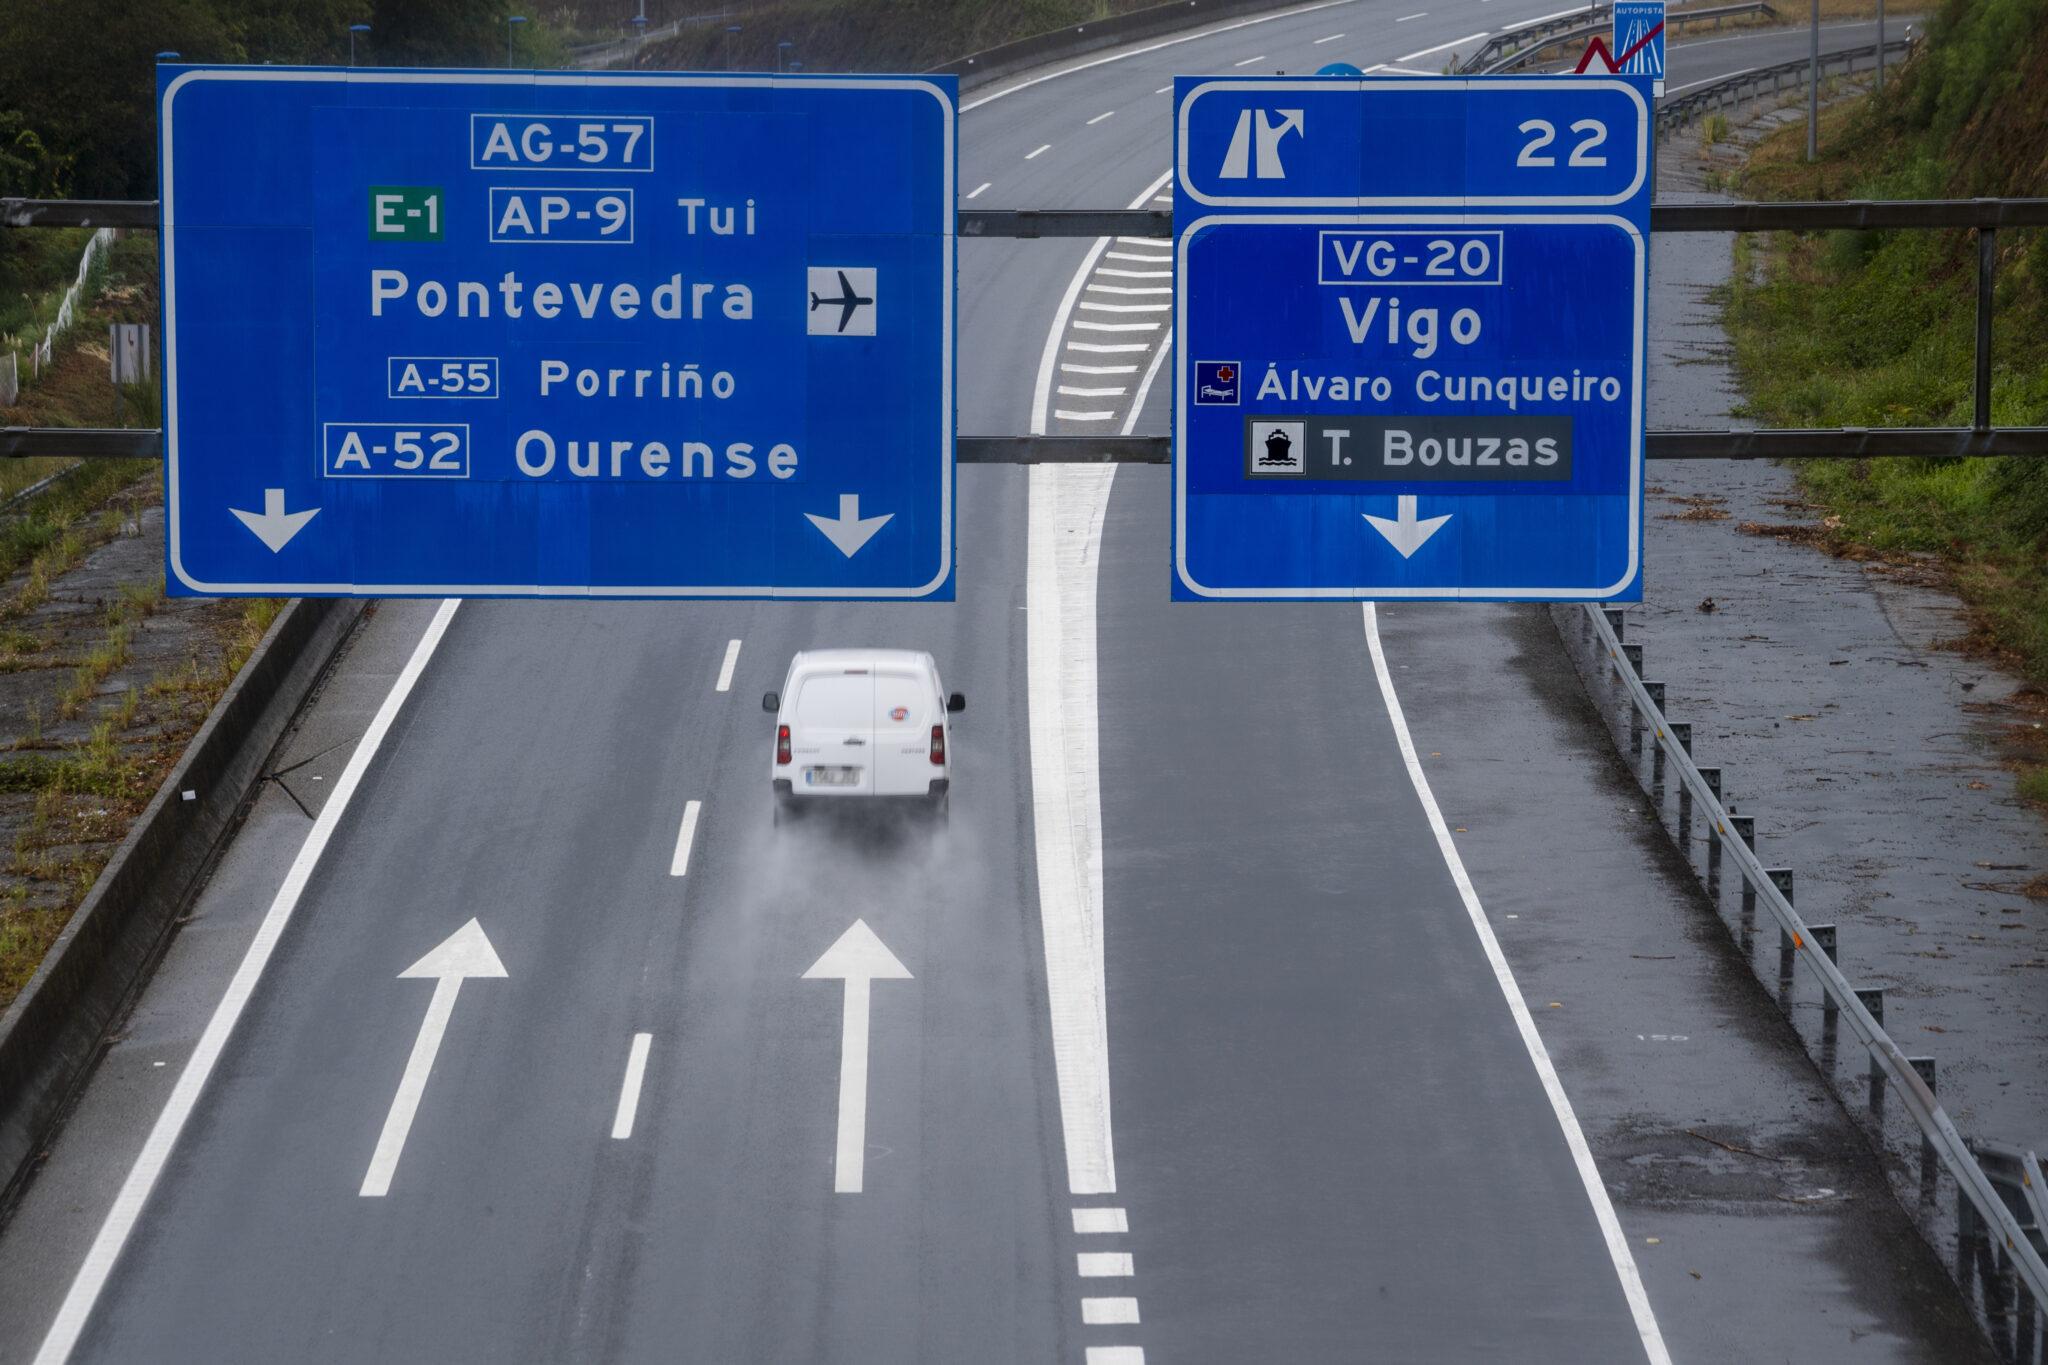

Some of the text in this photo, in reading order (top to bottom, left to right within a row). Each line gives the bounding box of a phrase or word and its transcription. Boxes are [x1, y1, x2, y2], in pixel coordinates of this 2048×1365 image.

[482, 123, 645, 164] AG-57
[1516, 118, 1608, 167] 22
[375, 194, 438, 233] E-1
[497, 196, 627, 235] AP-9
[677, 198, 755, 235] Tui
[1333, 239, 1491, 278] VG-20
[371, 269, 753, 320] Pontevedra
[1338, 297, 1482, 359] Vigo
[397, 363, 491, 393] A-55
[540, 360, 735, 399] Porriño
[1256, 362, 1621, 411] Álvaro Cunqueiro
[334, 431, 460, 470] A-52
[515, 429, 798, 480] Ourense
[1322, 429, 1559, 467] T. Bouzas
